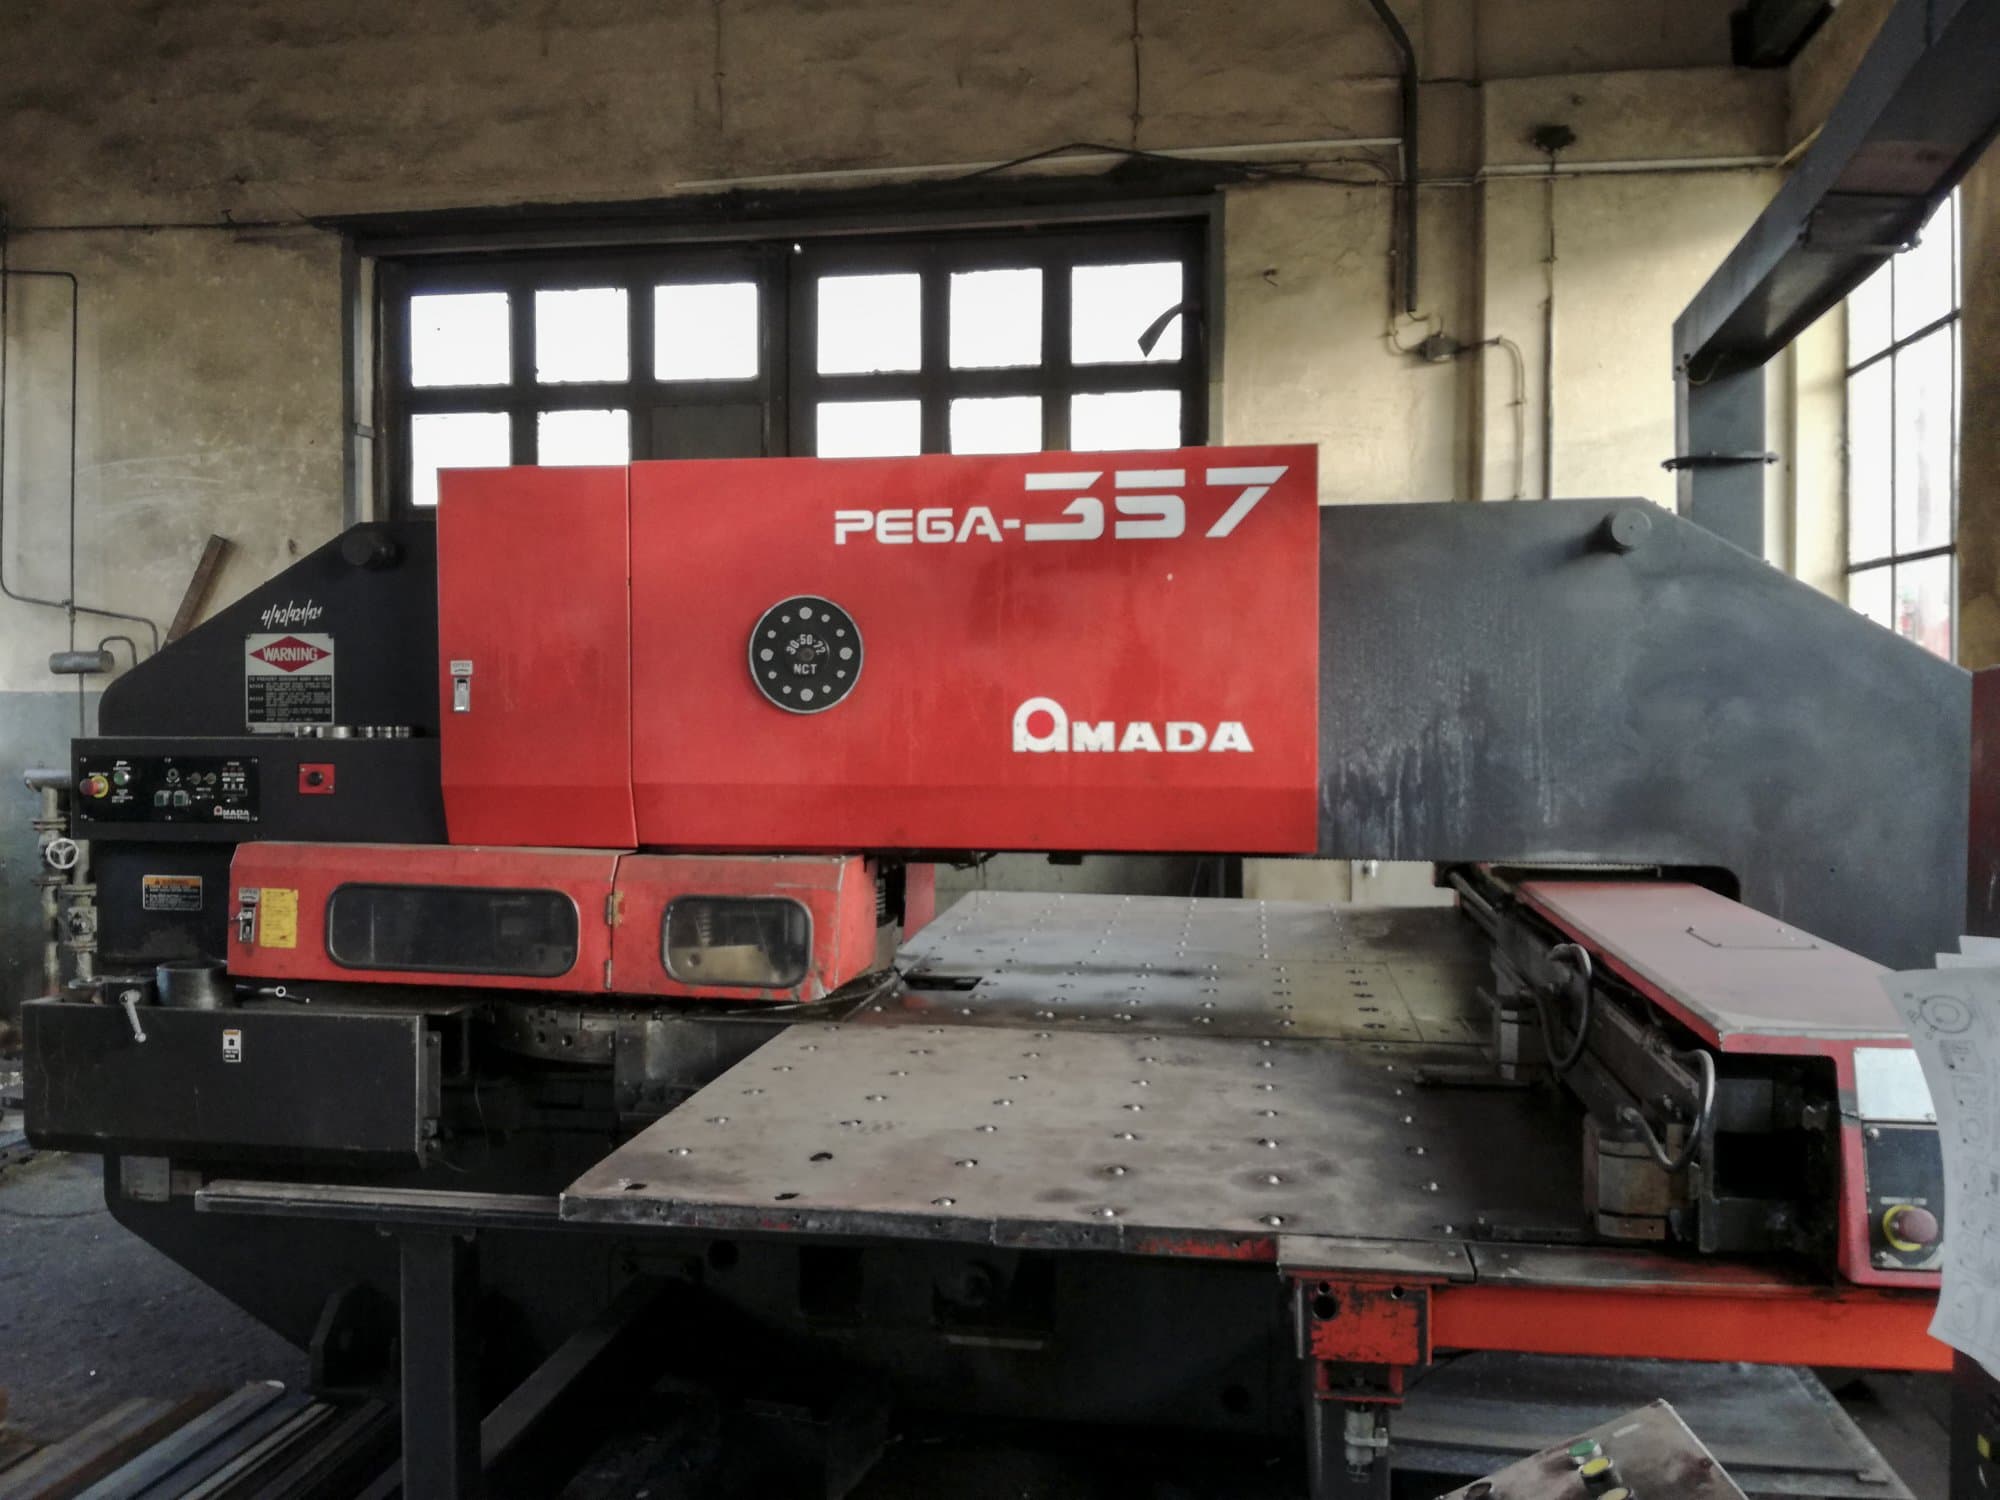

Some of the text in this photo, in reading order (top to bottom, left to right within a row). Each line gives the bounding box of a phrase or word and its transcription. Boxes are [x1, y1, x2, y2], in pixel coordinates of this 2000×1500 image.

[834, 465, 1289, 544] PEGA-357
[262, 647, 319, 662] WARNING
[793, 663, 818, 675] NCT
[1012, 696, 1255, 753] AMADA
